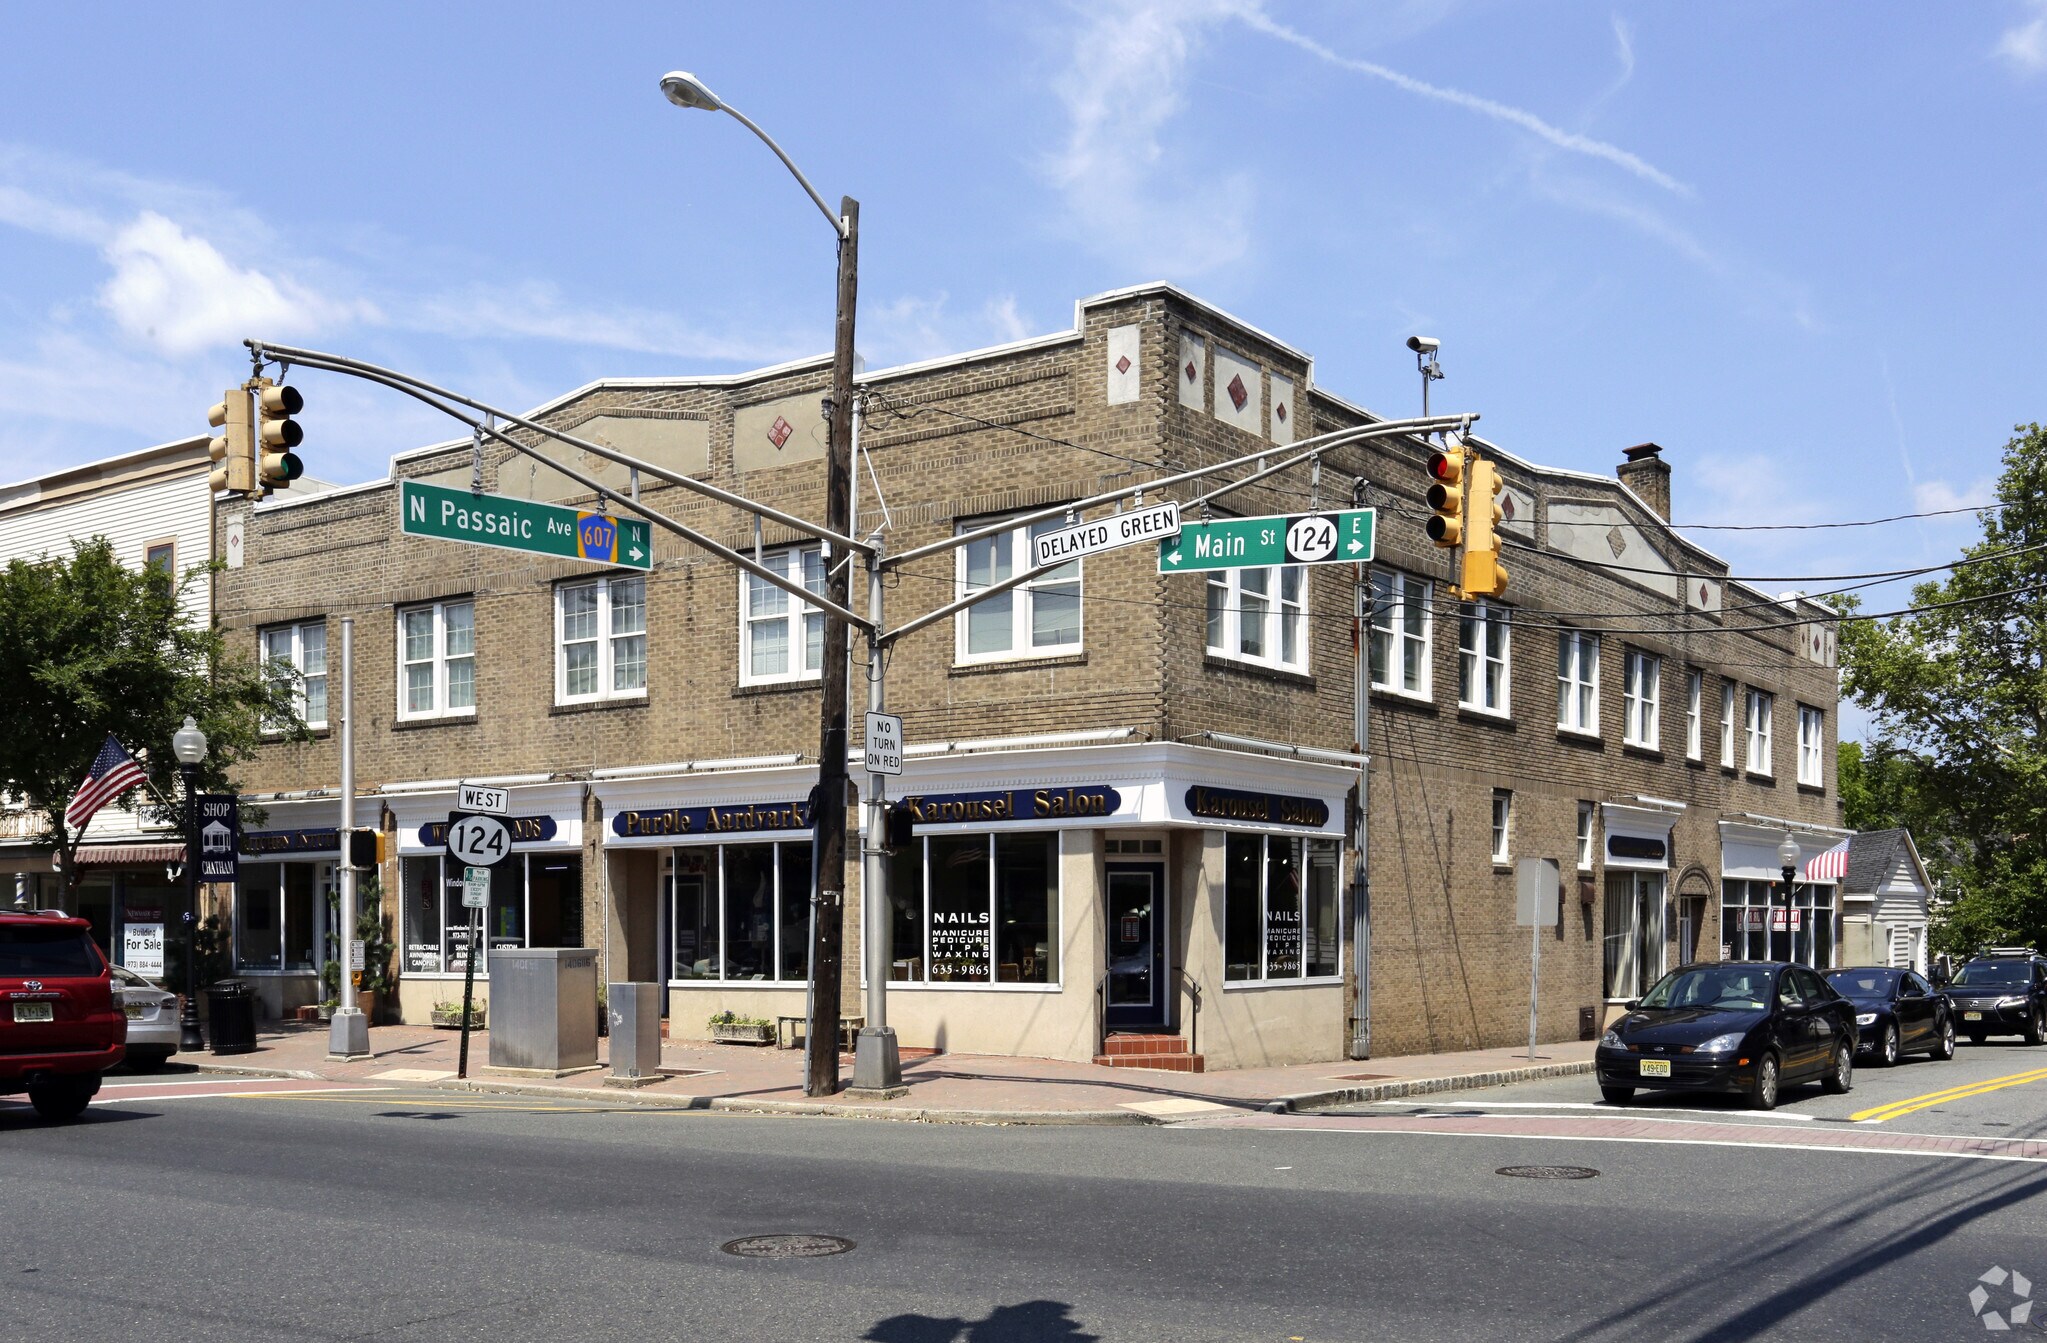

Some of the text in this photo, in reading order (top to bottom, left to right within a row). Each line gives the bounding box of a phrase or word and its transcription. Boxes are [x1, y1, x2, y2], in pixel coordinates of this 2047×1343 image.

[410, 495, 641, 549] N Passaic Ave 607 N
[1040, 509, 1174, 559] DELAYED GREEN
[1195, 532, 1245, 559] Main
[1260, 529, 1276, 546] St
[1292, 526, 1332, 553] 124
[1352, 517, 1361, 534] E
[877, 720, 891, 733] NO
[873, 736, 896, 751] TURN
[868, 753, 900, 768] ON RED
[465, 790, 502, 808] WEST
[906, 788, 1105, 822] Karousel Salon
[1196, 787, 1322, 825] Karousel Salon
[203, 802, 231, 817] SHOP
[625, 803, 805, 836] Purple Aardvark
[458, 825, 503, 856] 124
[201, 860, 234, 875] CHATHAM
[446, 878, 464, 887] Windo
[934, 912, 989, 924] NAILS
[1774, 911, 1783, 922] FOR
[133, 928, 156, 938] Building
[126, 938, 161, 950] For Sale
[126, 961, 138, 969] (973)
[932, 963, 989, 975] 635-9865
